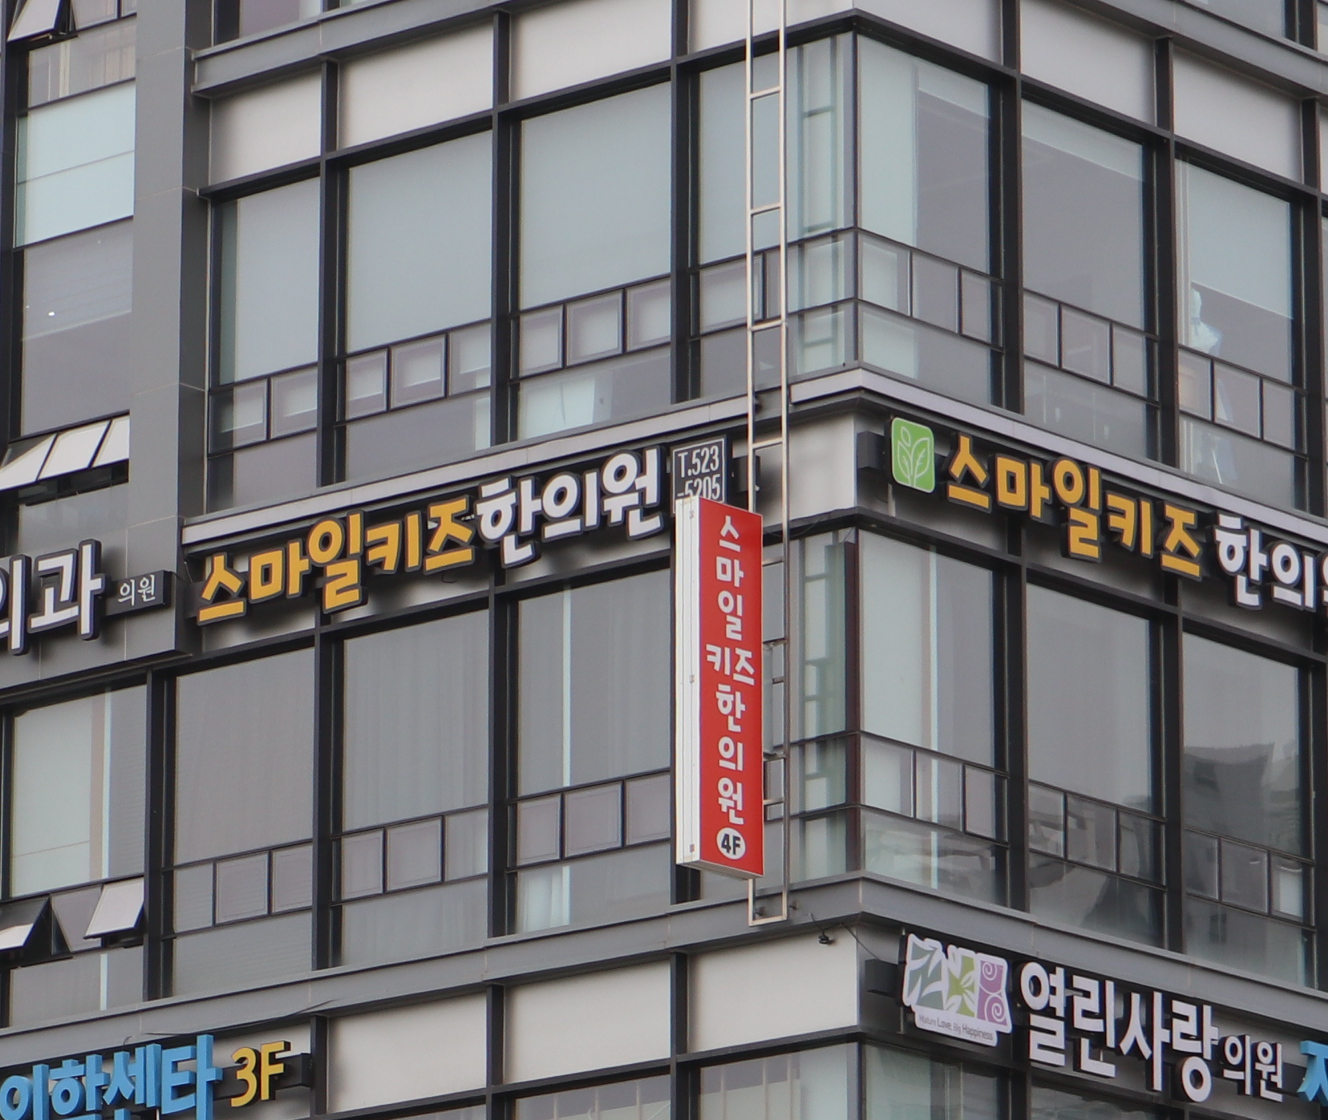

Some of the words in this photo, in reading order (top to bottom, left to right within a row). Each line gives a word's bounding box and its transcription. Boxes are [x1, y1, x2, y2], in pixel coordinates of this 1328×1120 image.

[677, 445, 719, 478] T.523
[117, 575, 156, 606] 의원
[720, 833, 741, 855] 4F
[231, 1041, 291, 1107] 3F
